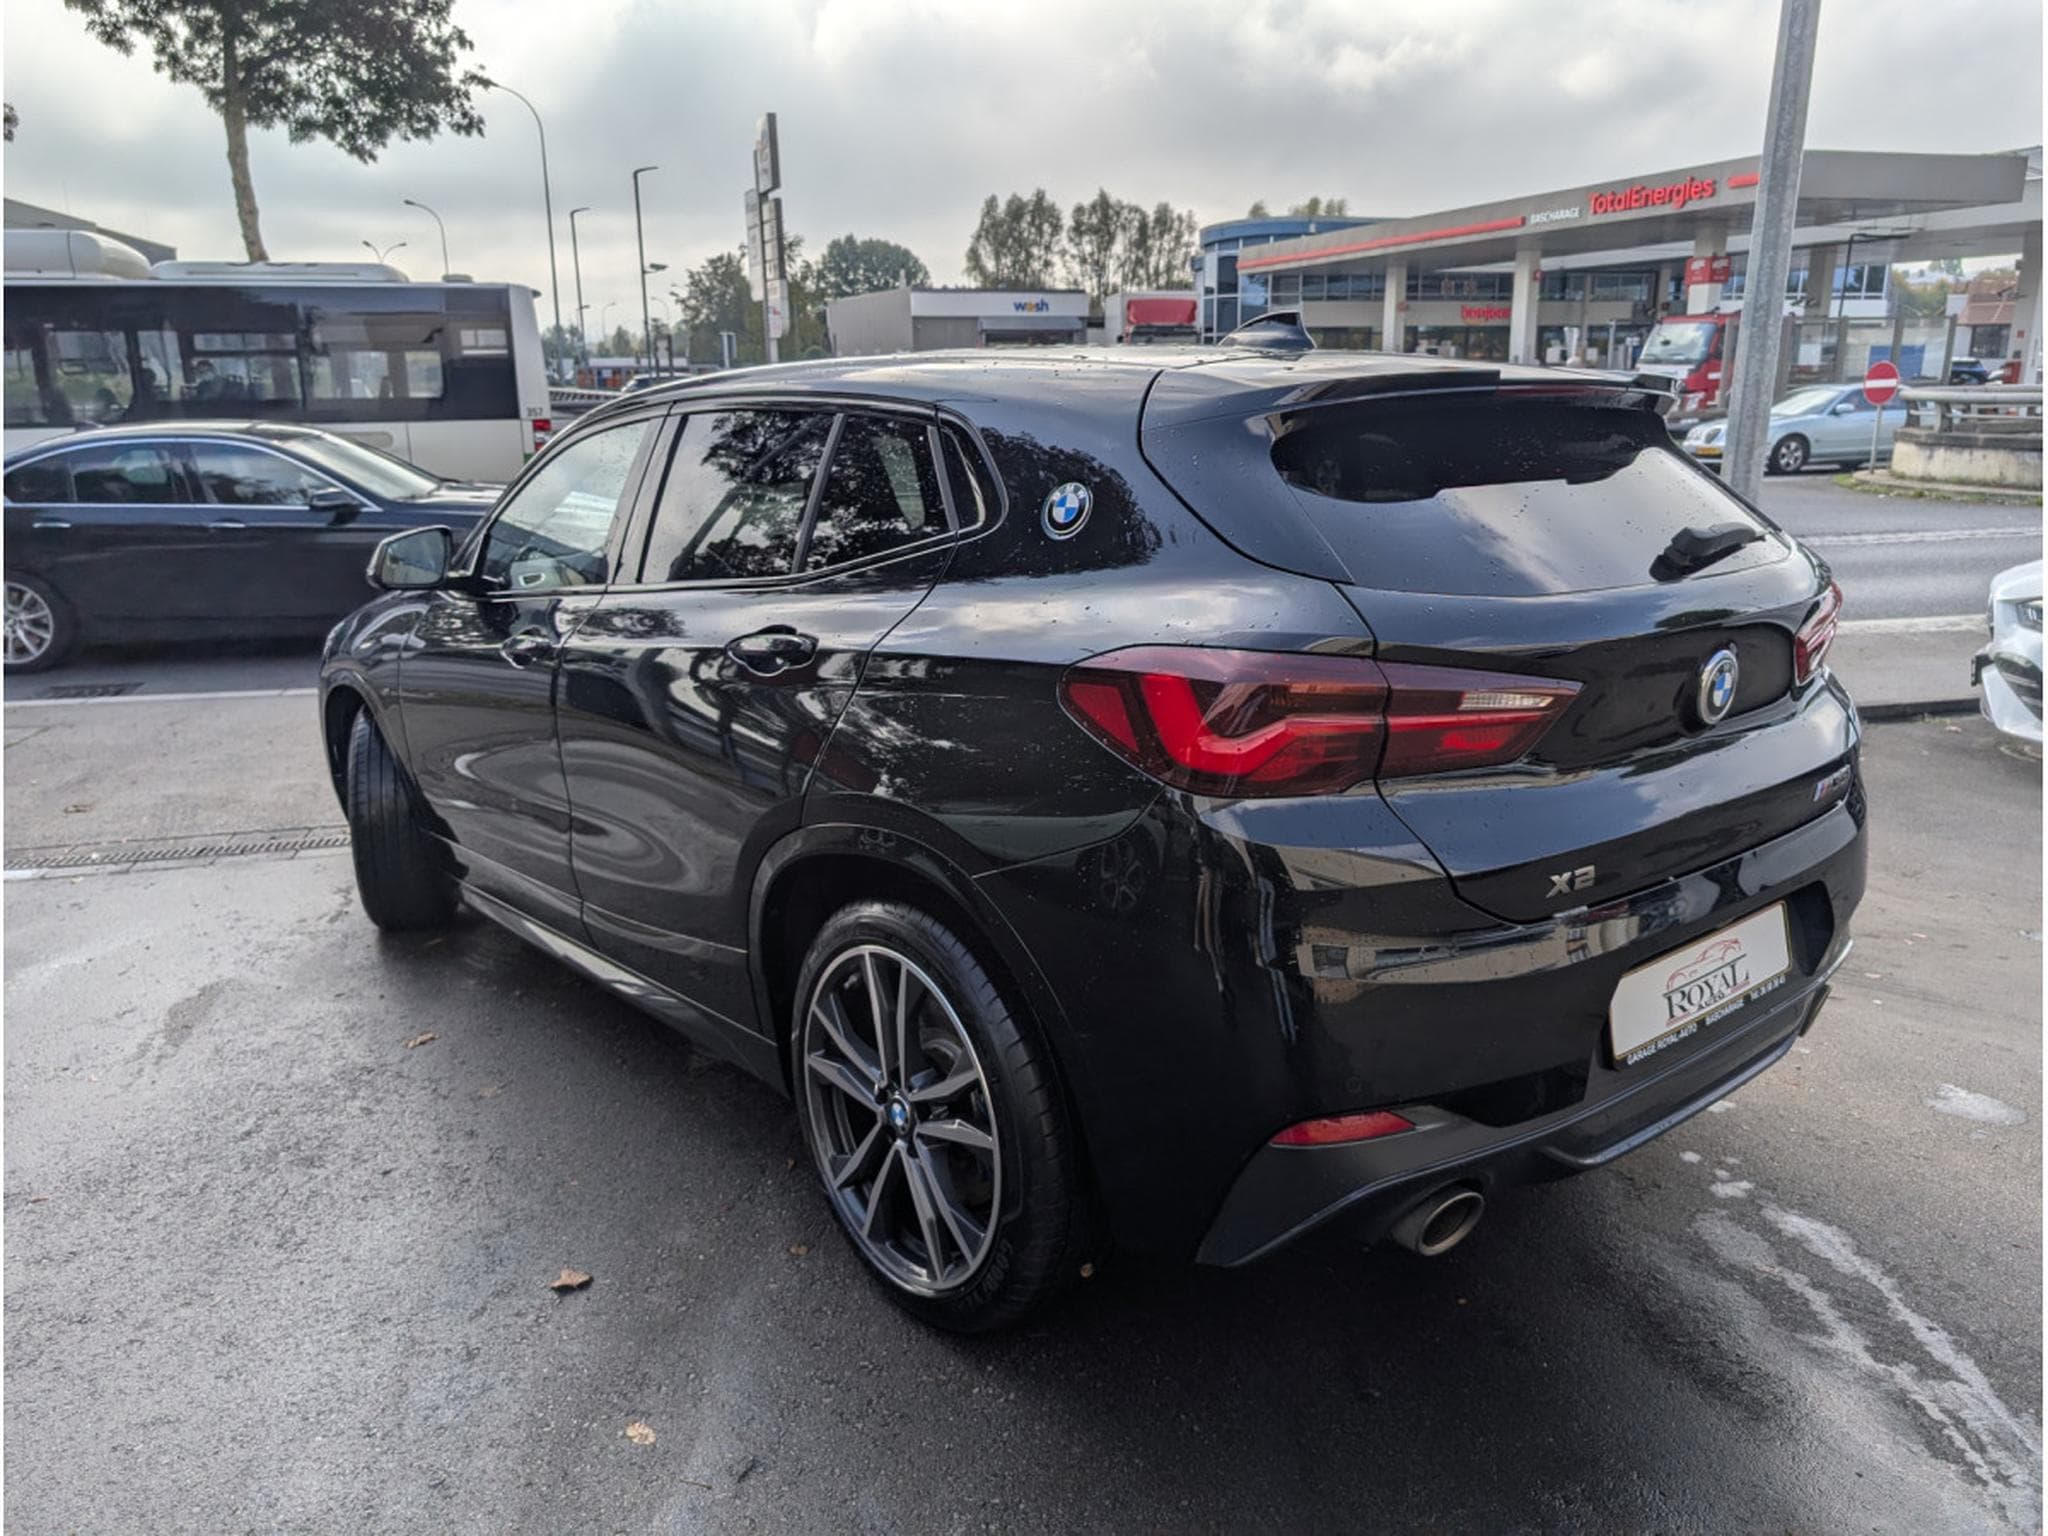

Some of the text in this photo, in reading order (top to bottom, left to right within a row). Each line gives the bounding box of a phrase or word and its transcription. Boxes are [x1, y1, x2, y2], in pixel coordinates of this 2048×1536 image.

[1530, 176, 1716, 225] BASCHARAGE TotalEnergies
[1013, 297, 1049, 313] wash
[1461, 304, 1512, 321] bonjou
[1545, 864, 1596, 898] X2
[1665, 962, 1749, 1019] ROYAL
[1697, 991, 1725, 1010] AUTO
